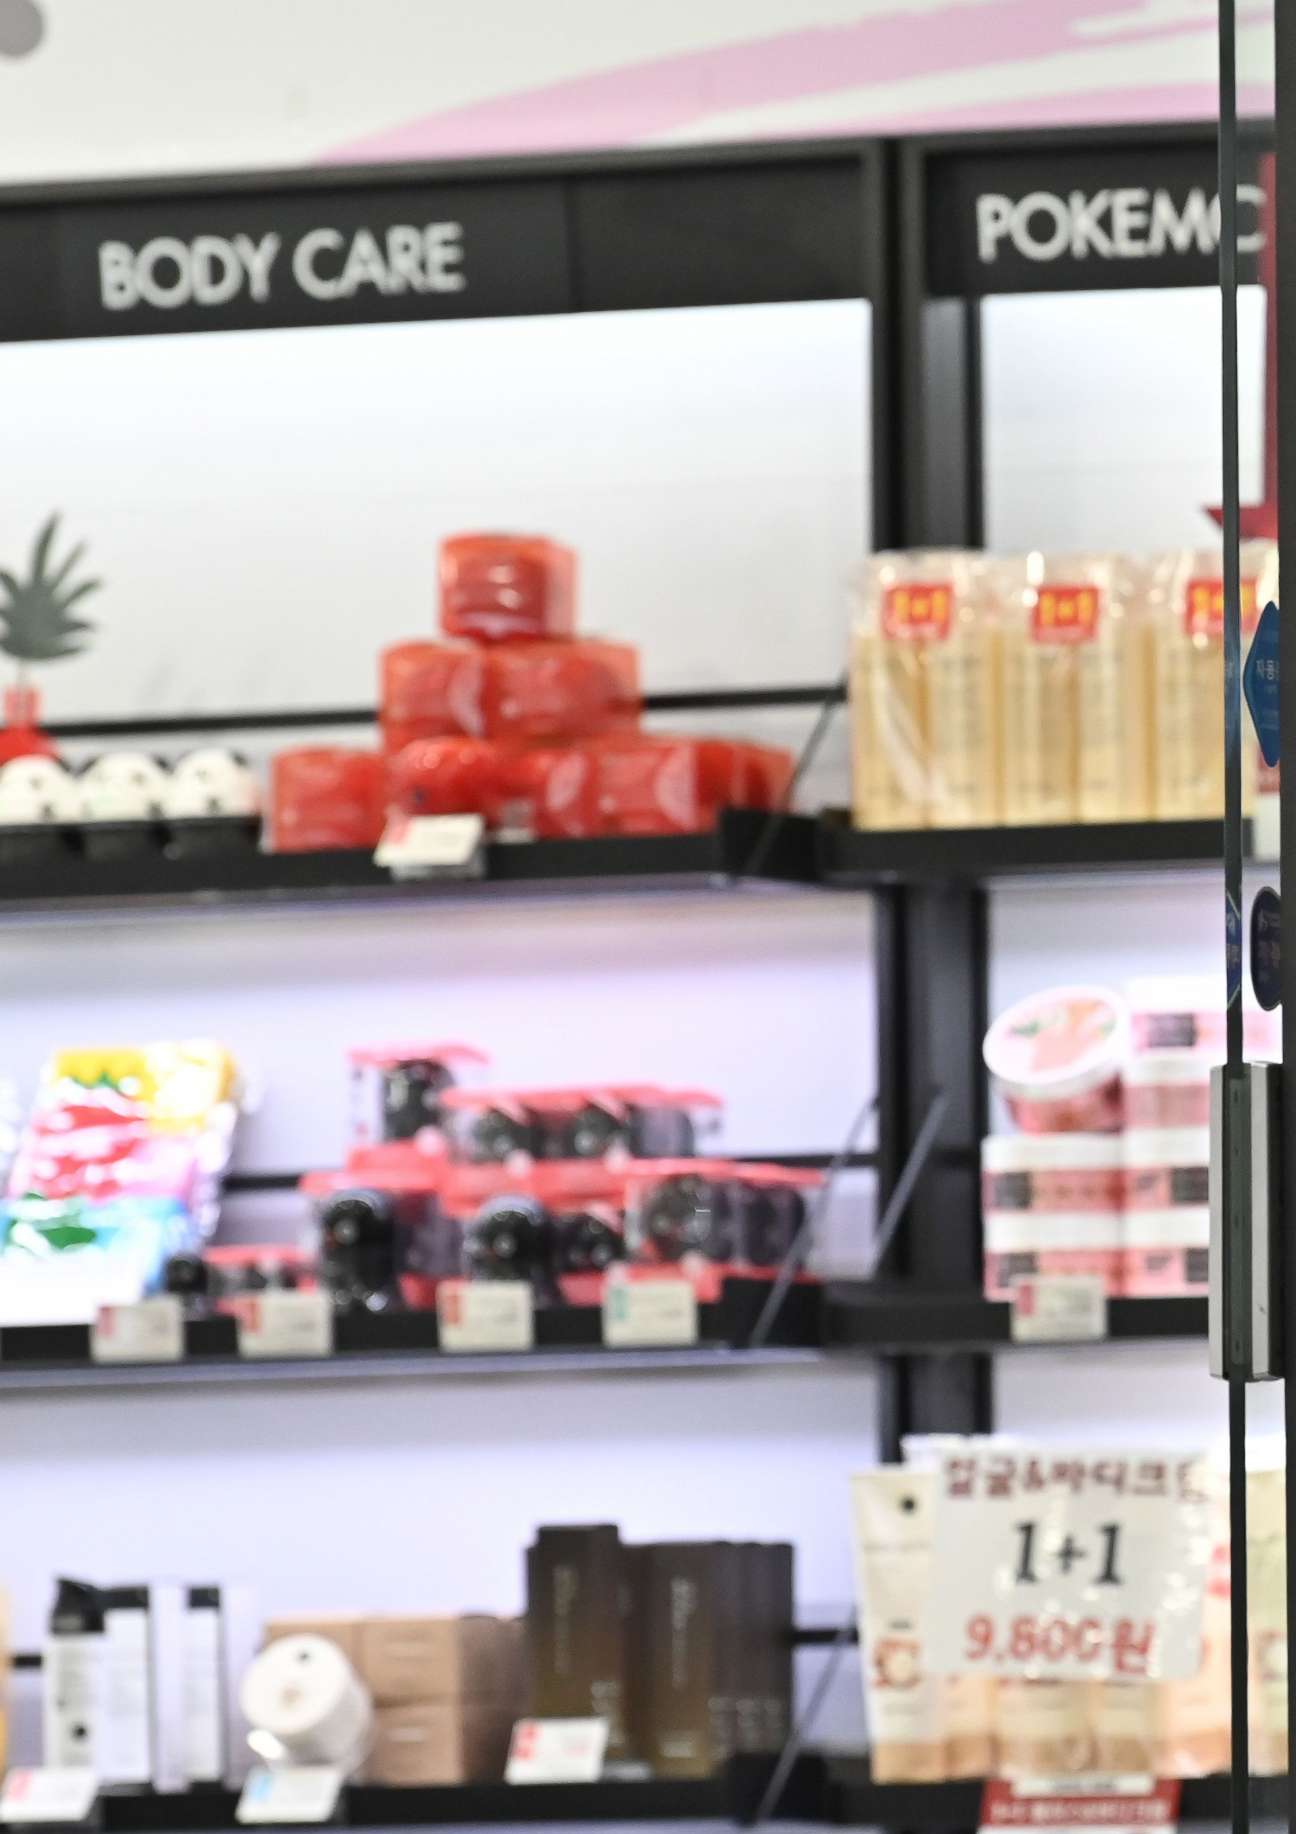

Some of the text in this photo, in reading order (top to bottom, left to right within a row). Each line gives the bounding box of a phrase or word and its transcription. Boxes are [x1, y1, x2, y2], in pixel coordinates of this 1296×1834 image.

[99, 221, 467, 312] BODY CARE
[1012, 1520, 1124, 1586] 1+1
